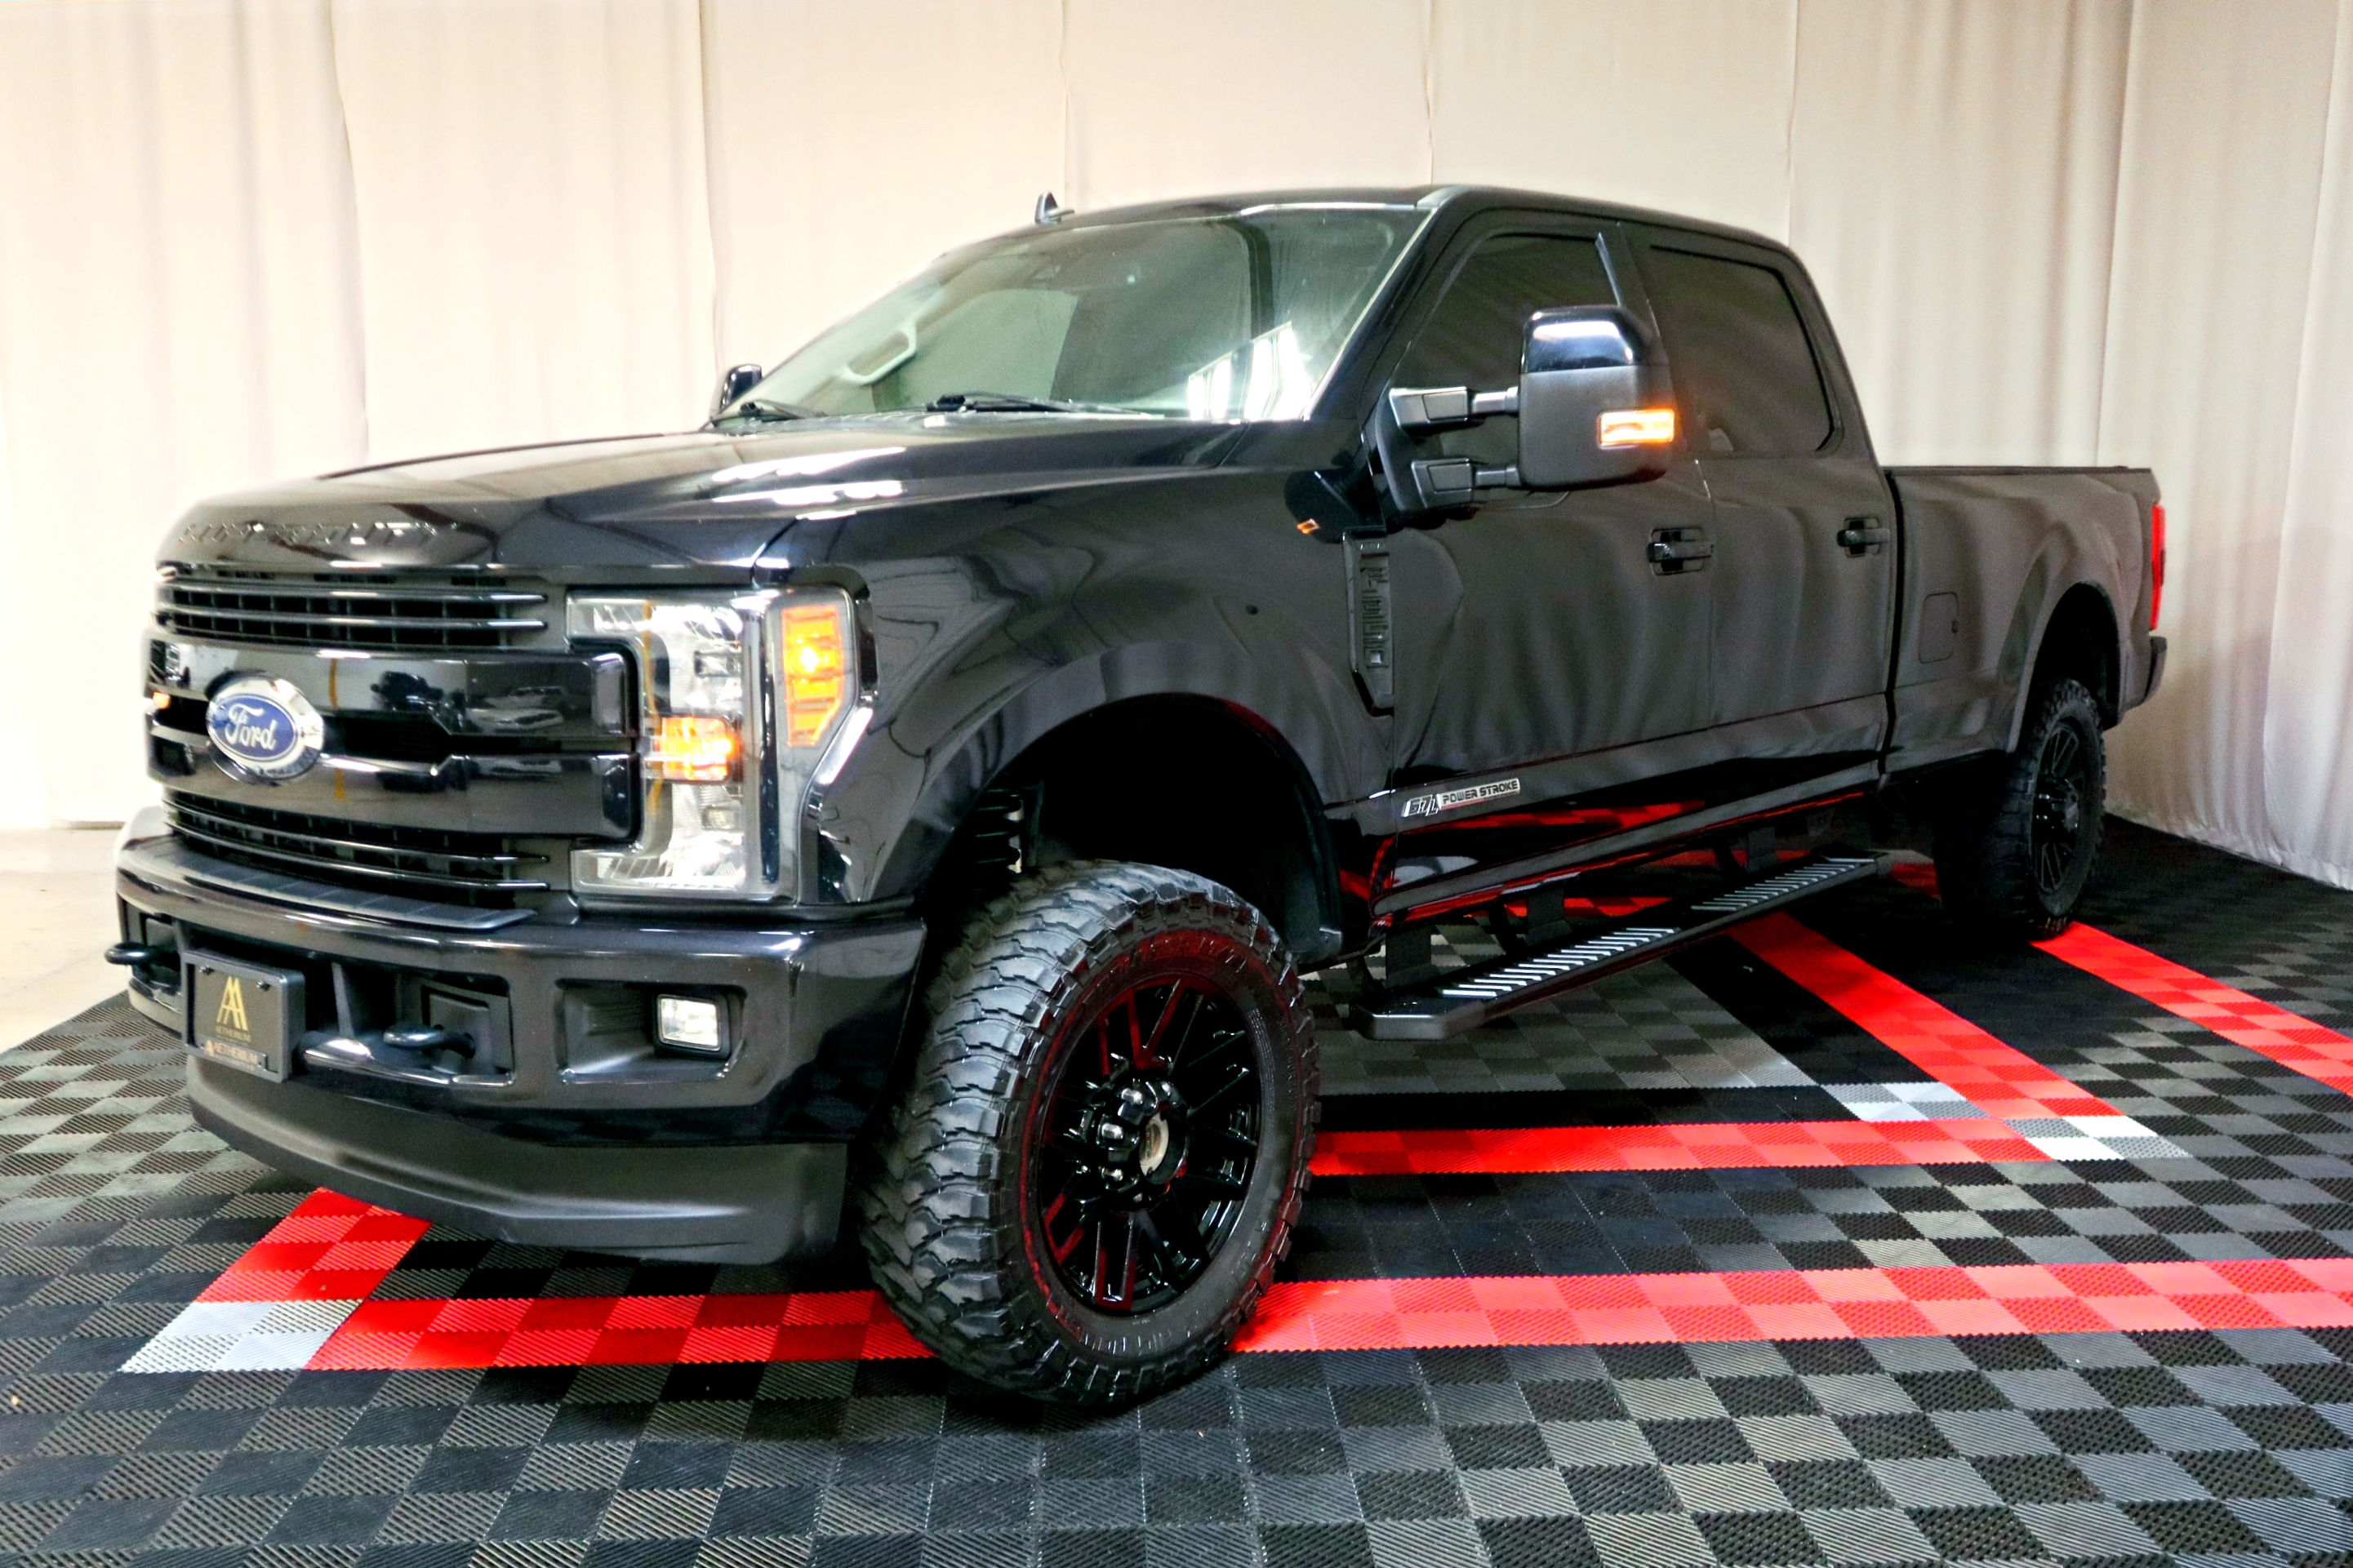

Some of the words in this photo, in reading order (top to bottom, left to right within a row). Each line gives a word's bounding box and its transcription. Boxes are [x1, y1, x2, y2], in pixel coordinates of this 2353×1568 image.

[225, 703, 278, 750] Ford
[1443, 789, 1478, 805] POWER
[1480, 780, 1518, 797] STROKE
